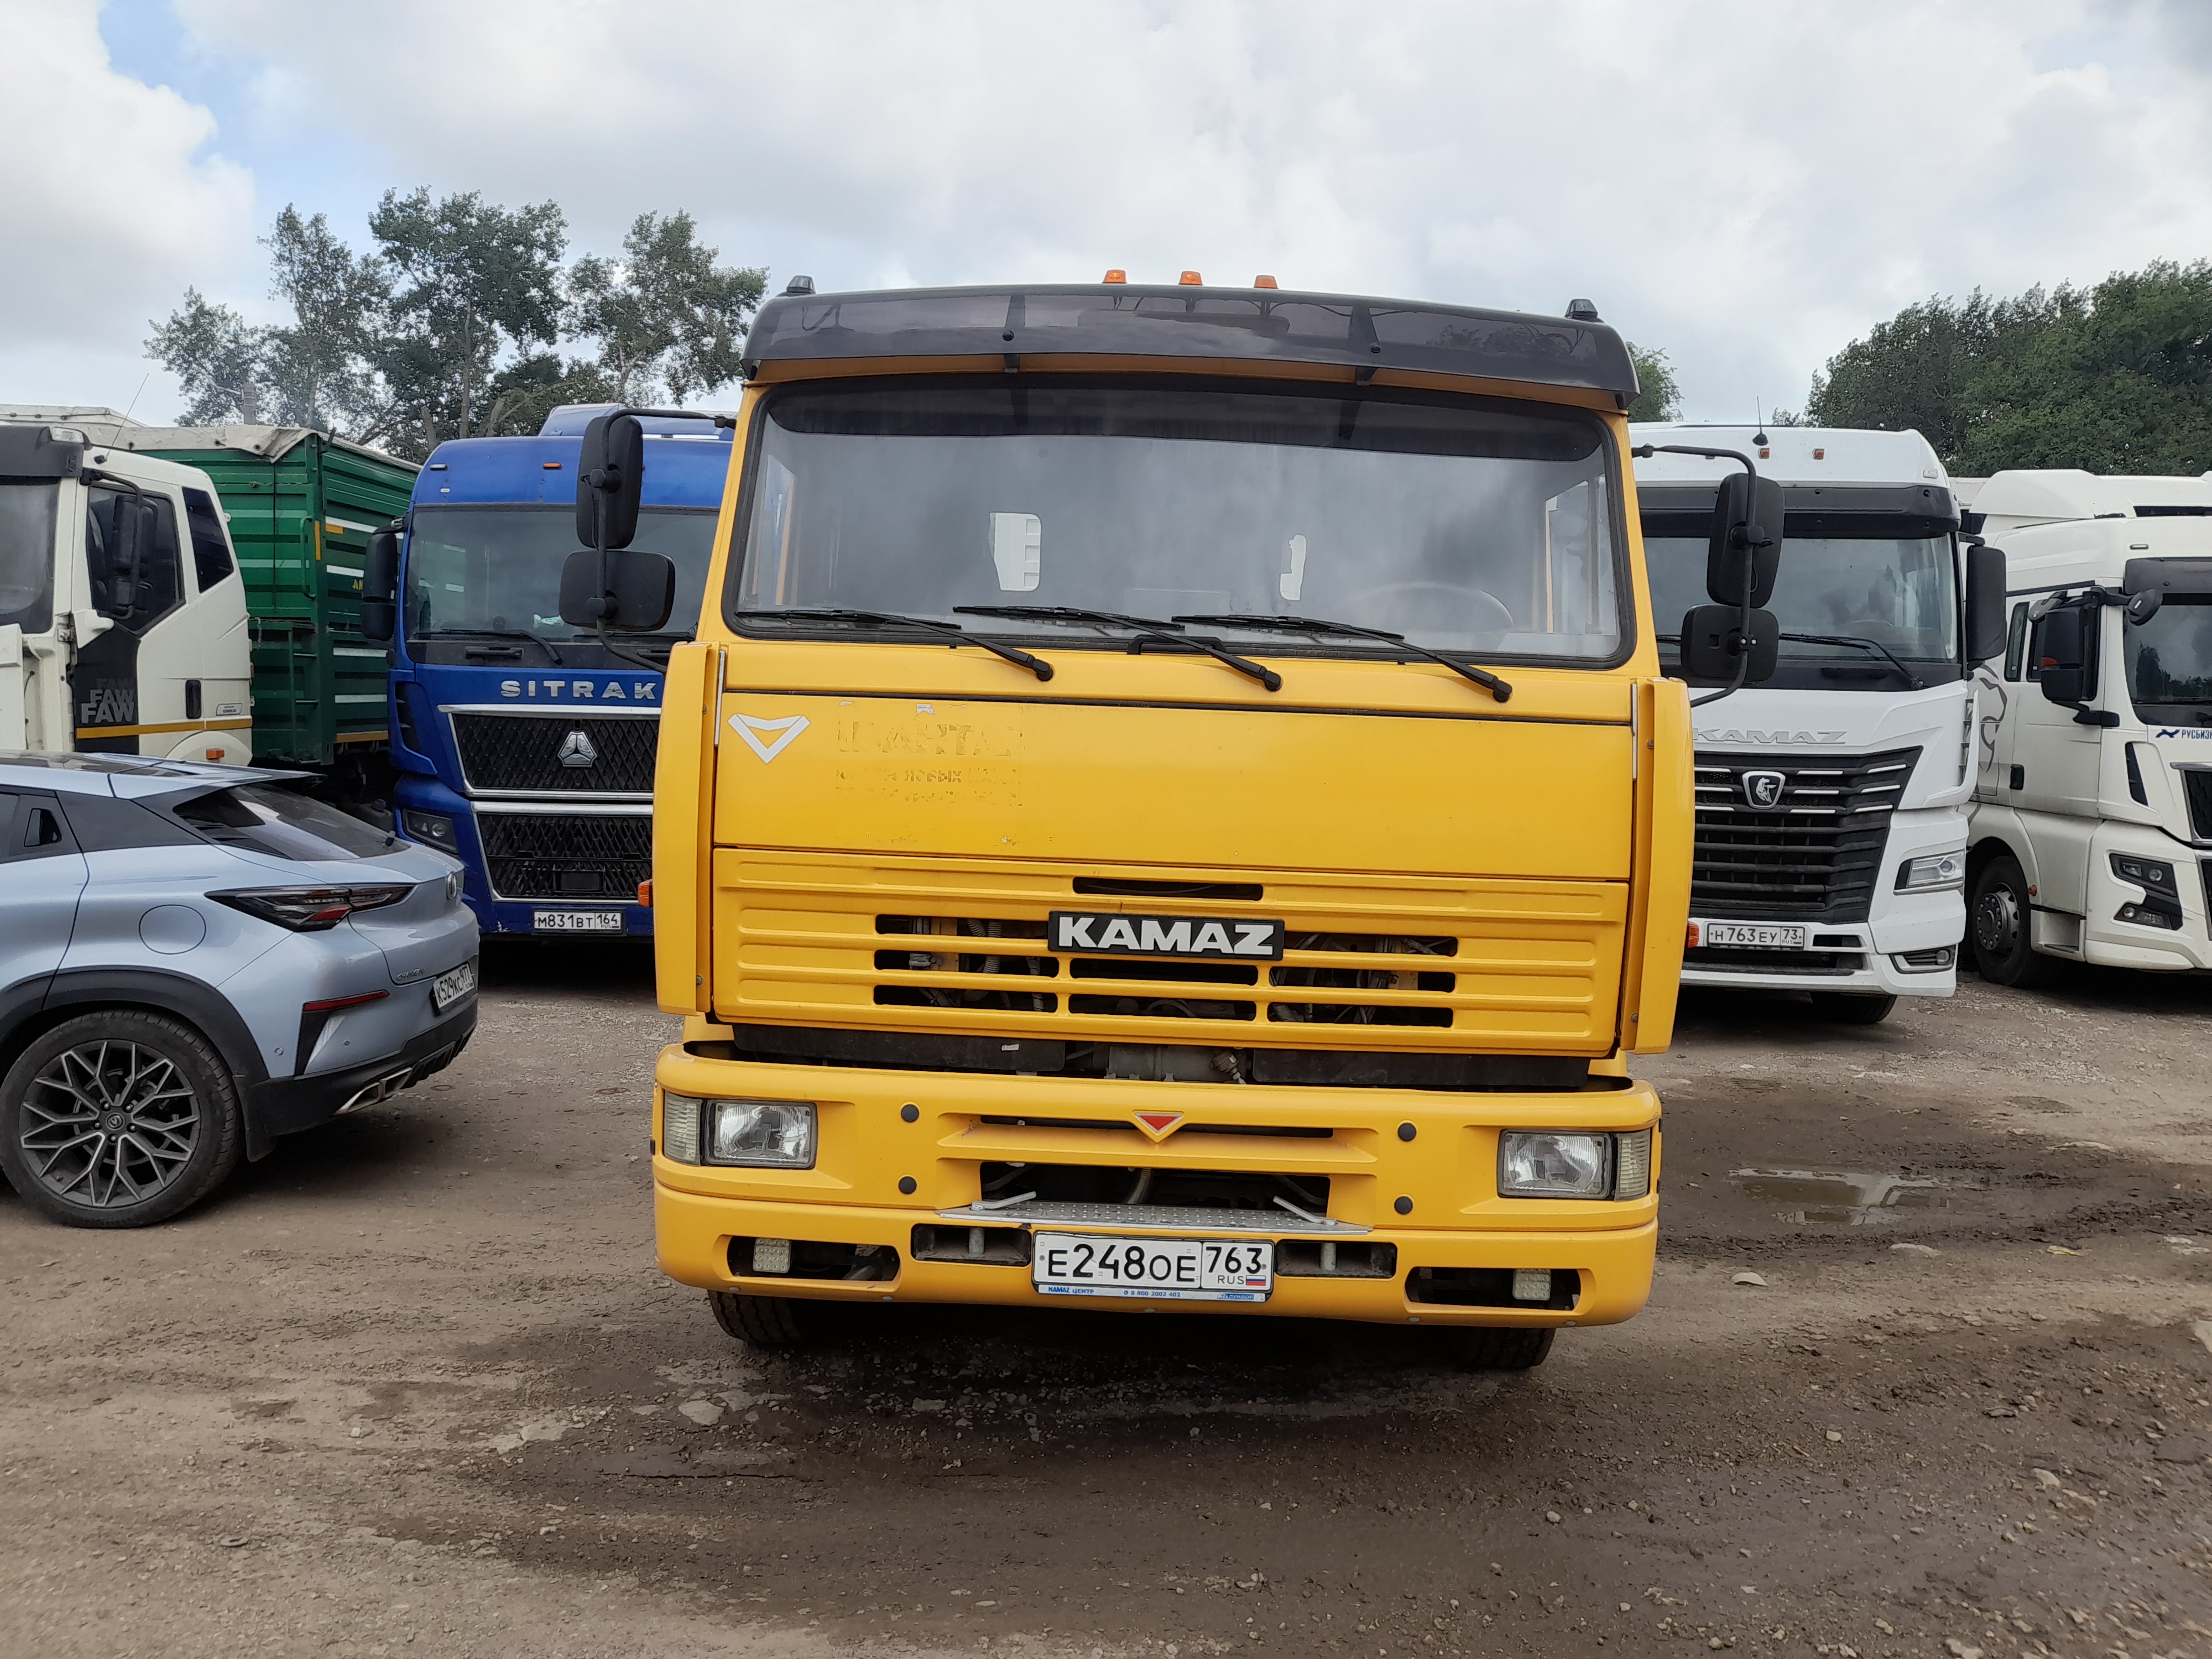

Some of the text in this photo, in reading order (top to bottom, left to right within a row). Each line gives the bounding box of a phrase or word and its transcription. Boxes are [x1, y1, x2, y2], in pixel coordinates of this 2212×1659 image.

[90, 689, 134, 704] FAW
[500, 680, 656, 700] SITRAK
[81, 701, 135, 724] FAW
[1693, 728, 1848, 744] KAMAZ
[596, 914, 618, 925] 164
[1058, 916, 1274, 956] KAMAZ
[1783, 929, 1798, 940] 73
[460, 966, 470, 983] 977
[1205, 1246, 1263, 1274] 763
[1217, 1275, 1245, 1285] RUS
